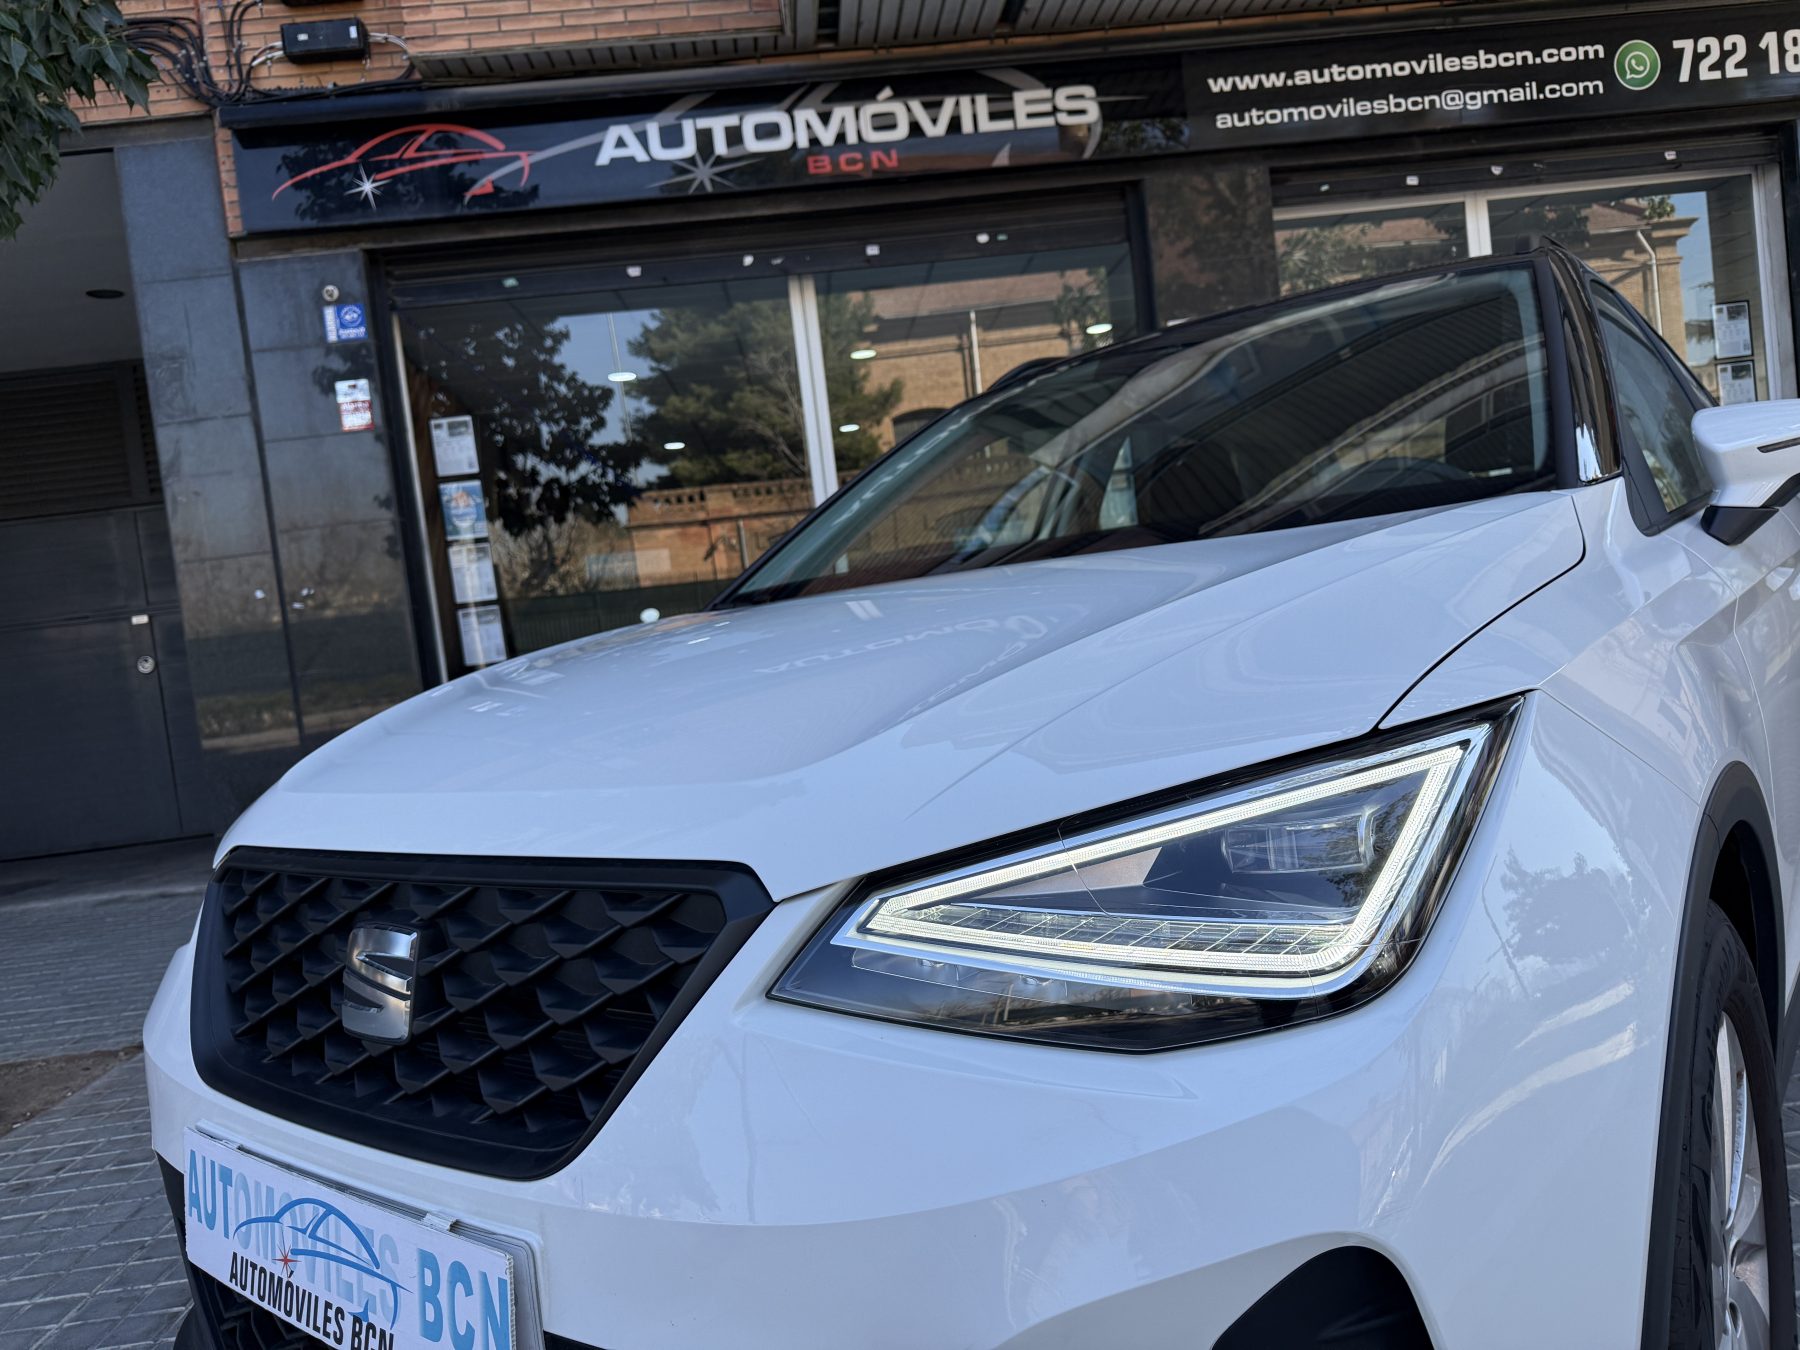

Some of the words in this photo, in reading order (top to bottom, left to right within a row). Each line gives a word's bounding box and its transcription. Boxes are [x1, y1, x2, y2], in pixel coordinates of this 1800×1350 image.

[1206, 43, 1606, 94] www.automovilesbcn.com
[1672, 34, 1749, 83] 722
[594, 84, 1100, 167] AUTOMÓVILES
[1214, 79, 1605, 130] automovilesbcn@gmail.com
[806, 148, 899, 175] BCN
[229, 1251, 346, 1346] AUTOMÓVILES
[417, 1247, 512, 1350] BCN
